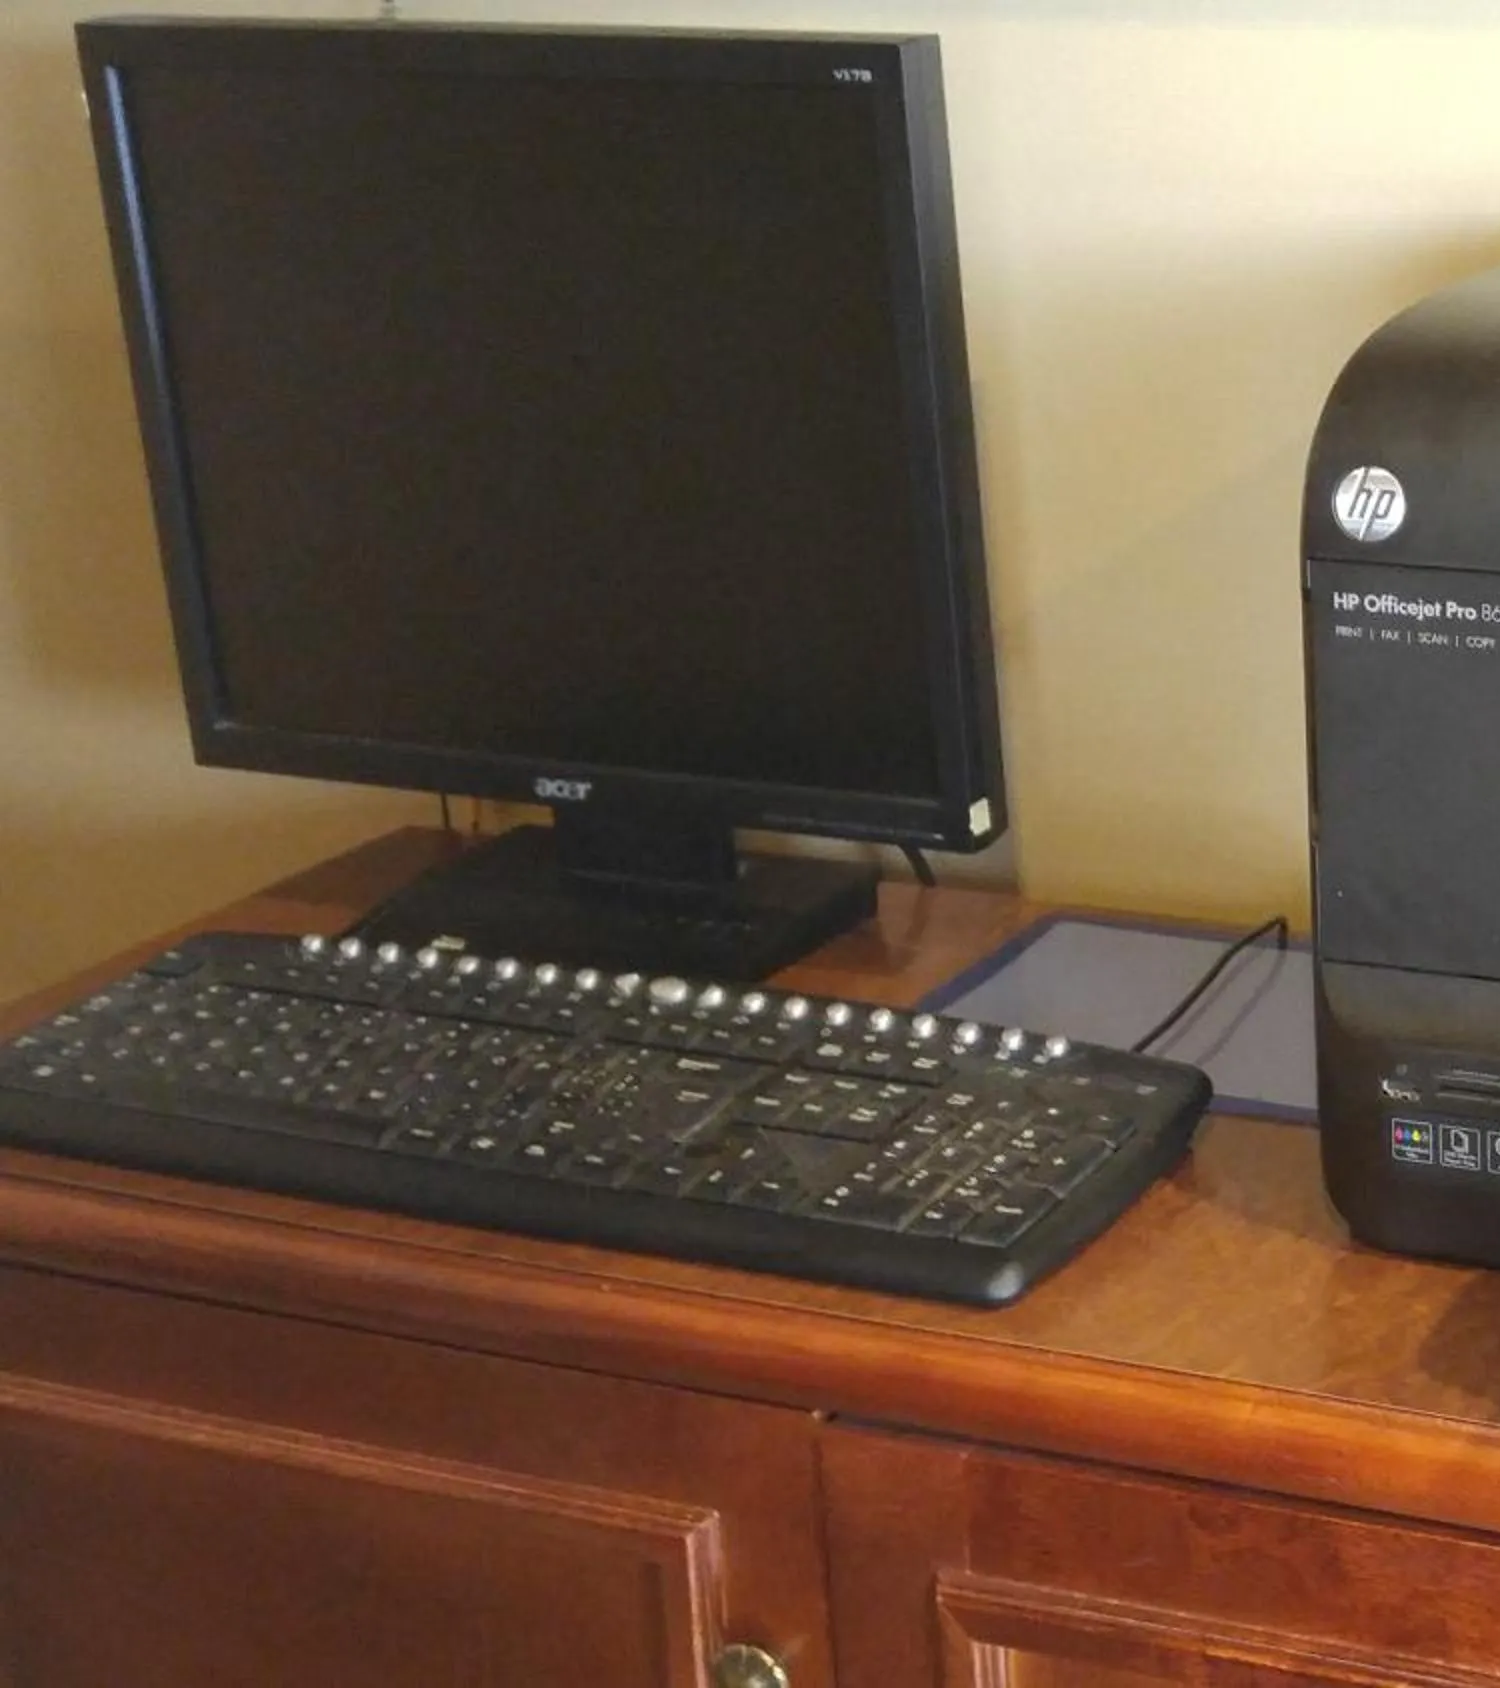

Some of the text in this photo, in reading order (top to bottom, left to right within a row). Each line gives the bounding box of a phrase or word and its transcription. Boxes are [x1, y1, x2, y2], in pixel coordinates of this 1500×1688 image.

[1346, 466, 1398, 541] hp
[1333, 591, 1360, 611] HP
[1363, 593, 1441, 621] Officejet
[1445, 600, 1477, 621] Pro
[533, 777, 592, 801] acer
